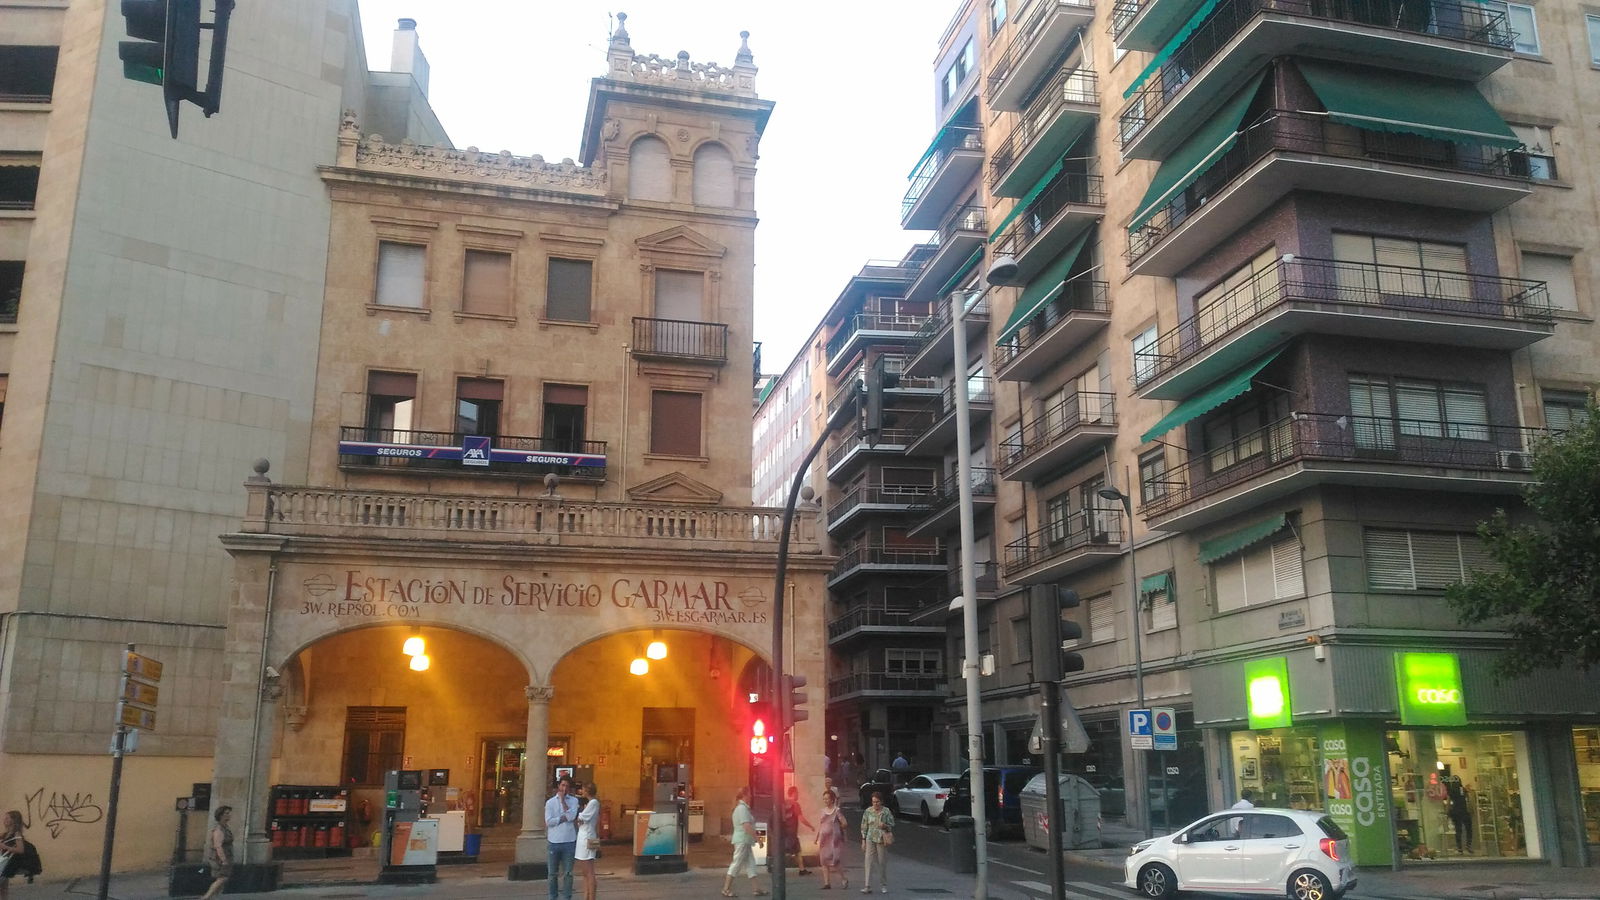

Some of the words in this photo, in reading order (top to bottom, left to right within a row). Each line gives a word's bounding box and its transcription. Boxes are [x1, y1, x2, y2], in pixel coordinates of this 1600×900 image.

[377, 448, 422, 457] SEGUROS
[463, 448, 485, 459] AXA
[526, 455, 569, 464] SEGUROS
[473, 586, 495, 606] DE
[611, 578, 733, 613] GARMAR
[1133, 713, 1148, 733] P
[1323, 739, 1347, 751] casa
[1352, 757, 1376, 827] casa
[1373, 765, 1386, 818] ENTRADA
[1330, 804, 1353, 815] casa
